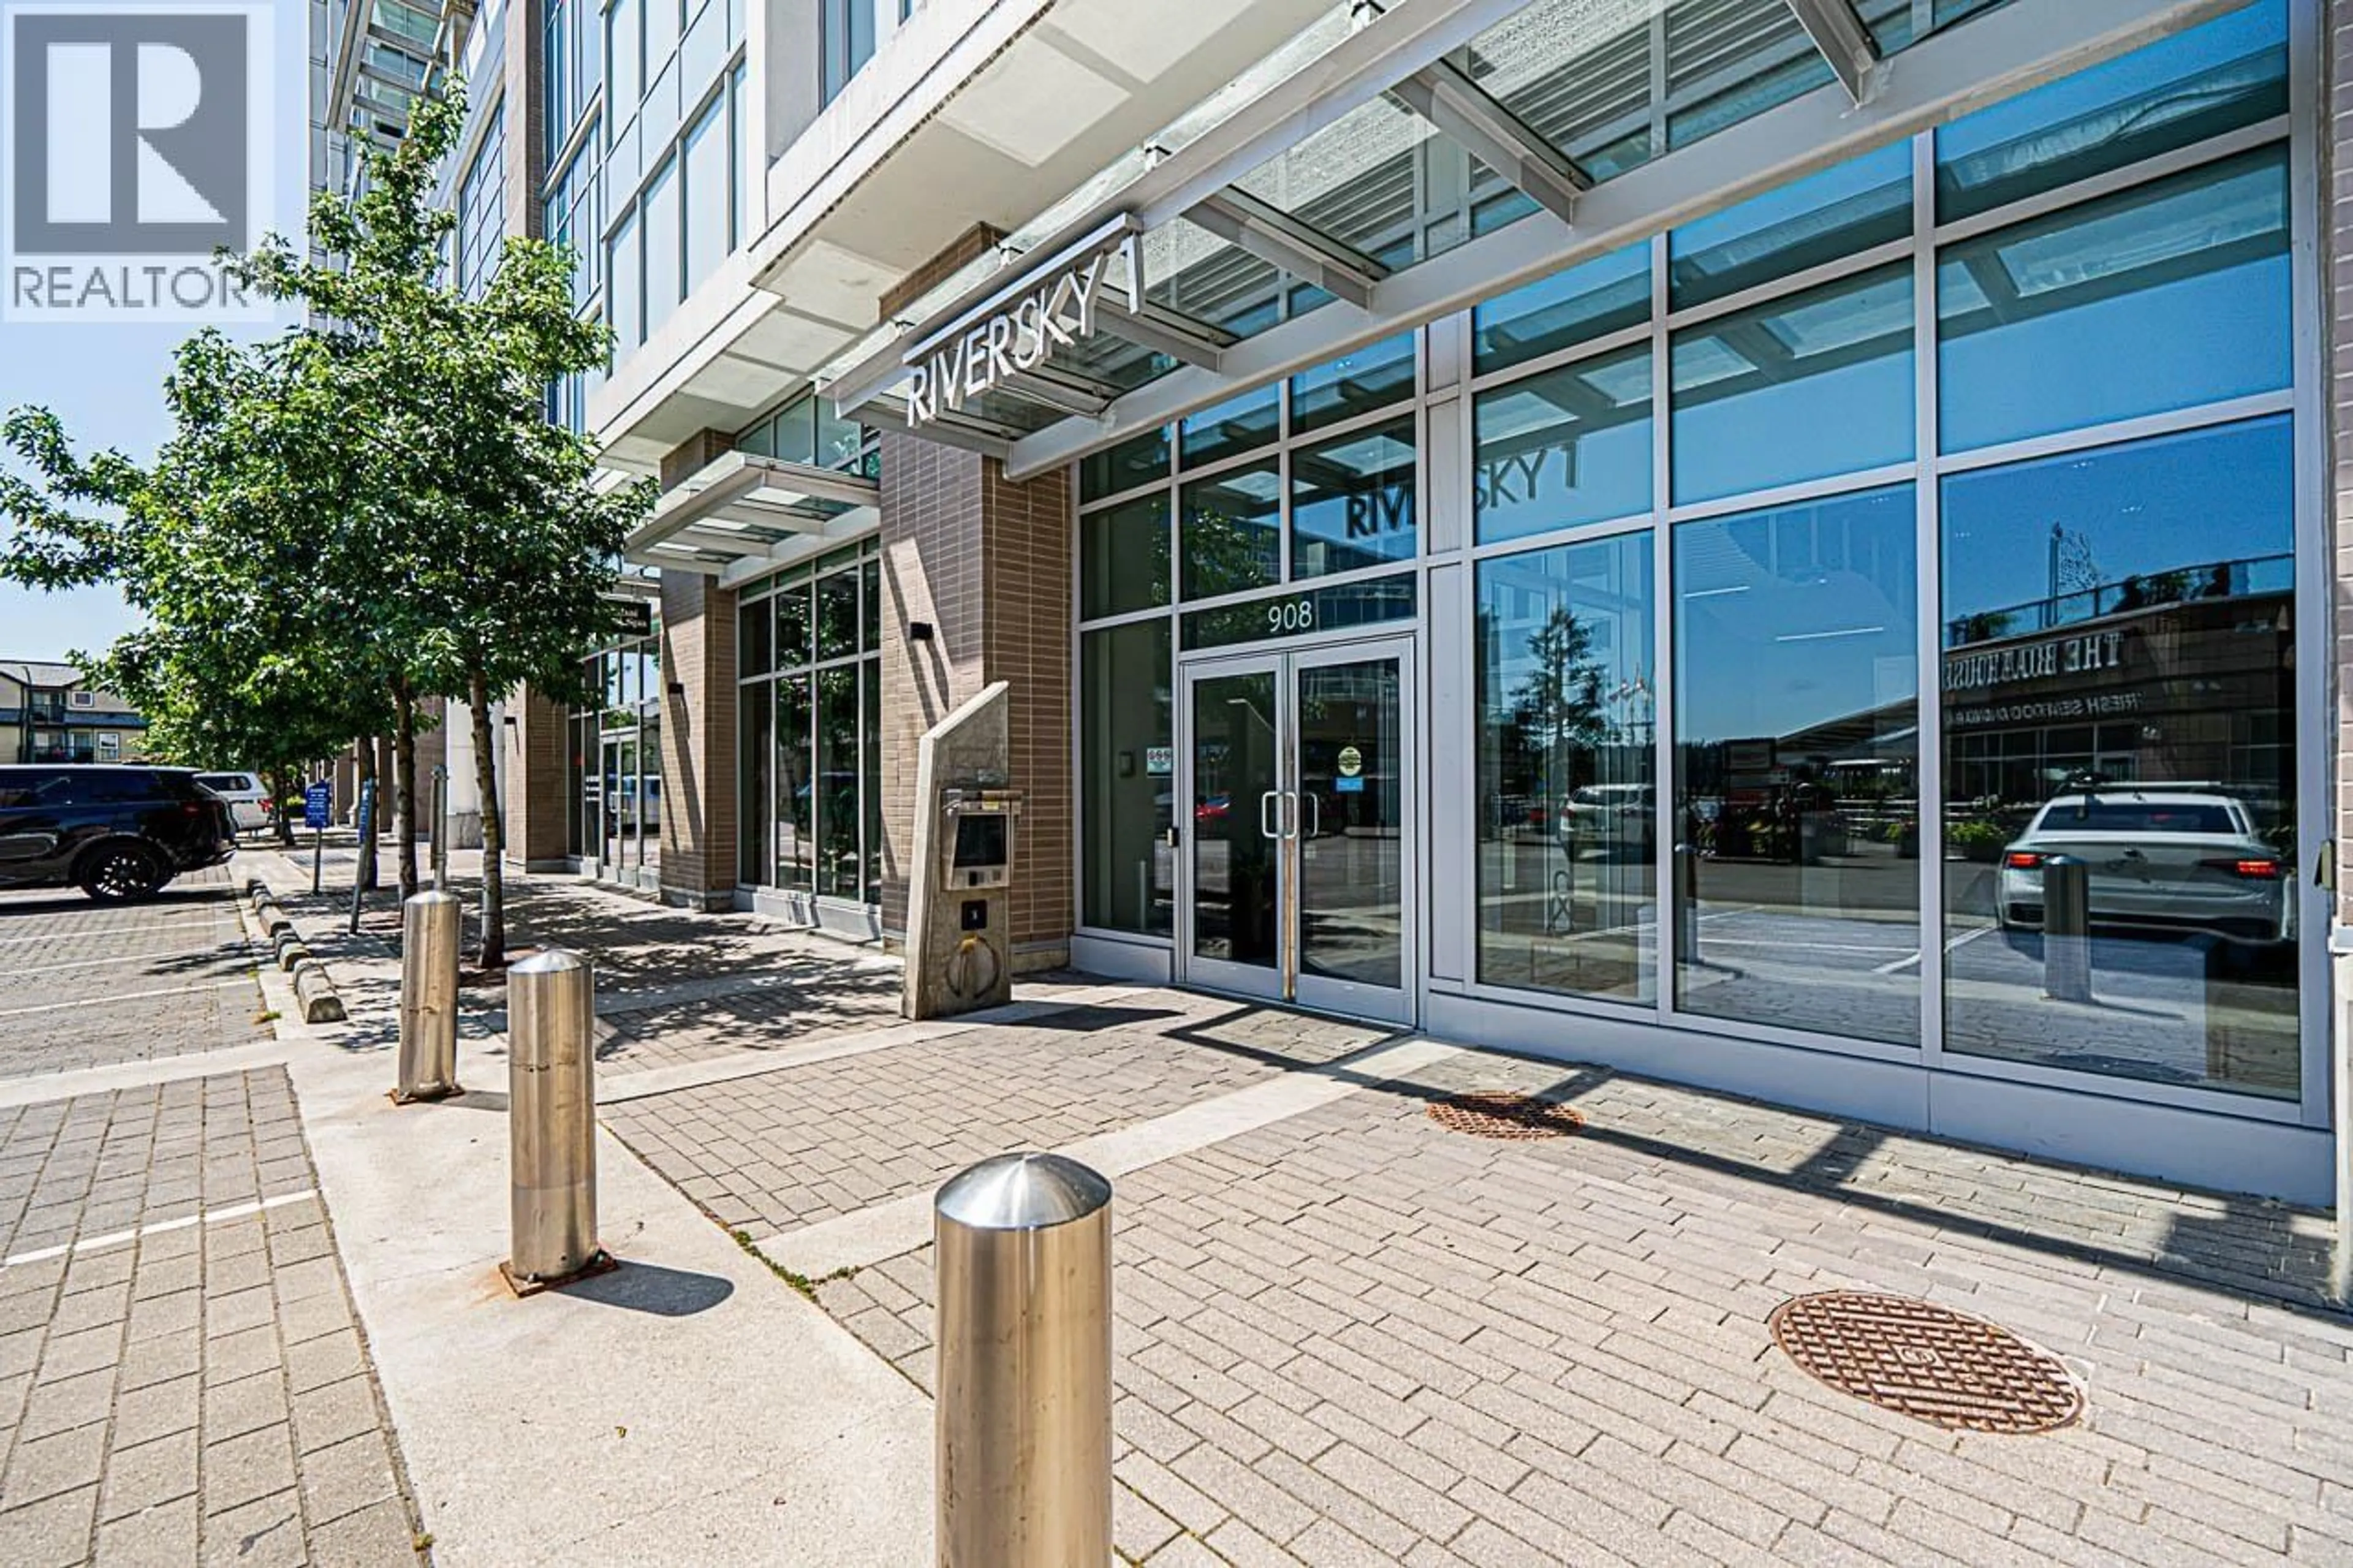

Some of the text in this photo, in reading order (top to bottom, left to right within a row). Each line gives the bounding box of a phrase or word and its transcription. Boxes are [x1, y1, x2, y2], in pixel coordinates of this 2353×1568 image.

[907, 229, 1146, 428] RIVERSKY 1
[1268, 600, 1312, 632] 908
